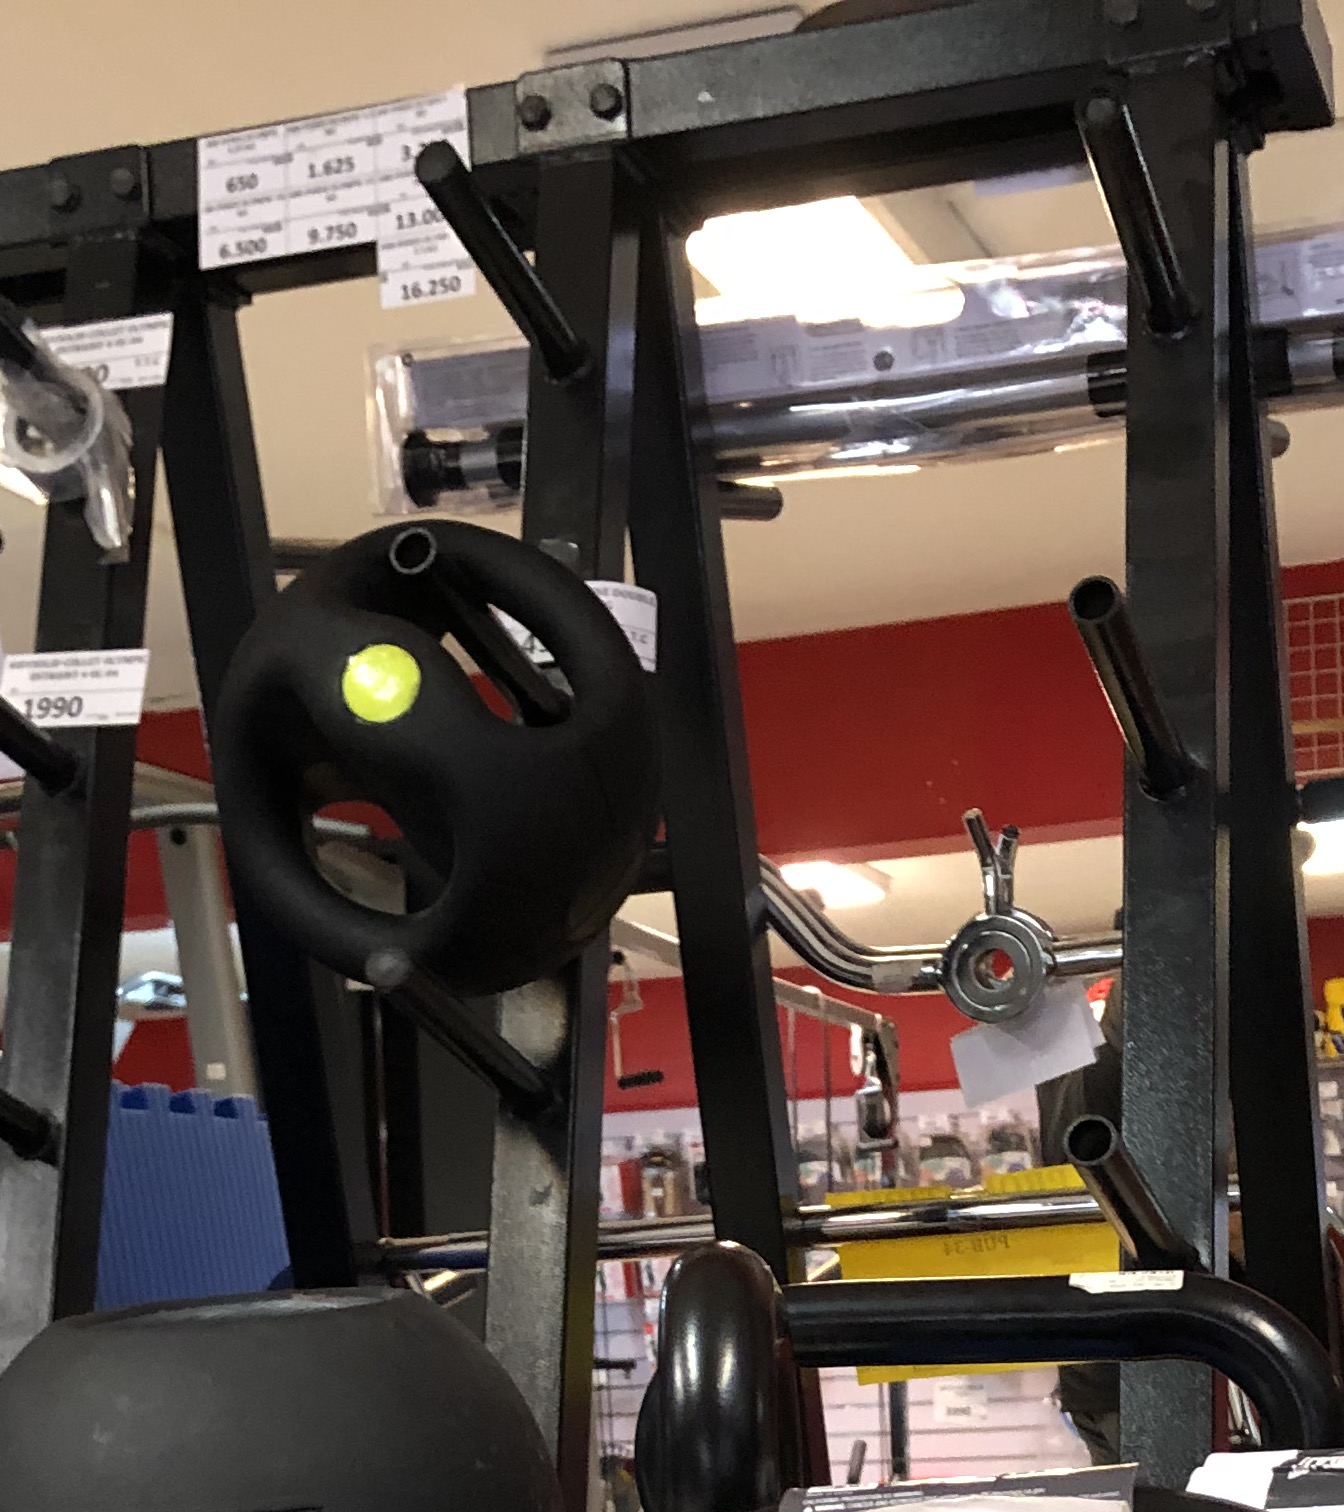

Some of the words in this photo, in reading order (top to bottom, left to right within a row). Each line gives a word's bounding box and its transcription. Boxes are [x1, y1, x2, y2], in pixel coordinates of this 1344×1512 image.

[307, 157, 355, 179] 1.625
[225, 172, 259, 193] 650
[218, 237, 268, 259] 6.500
[400, 275, 461, 300] 16.250
[24, 696, 83, 720] 1990
